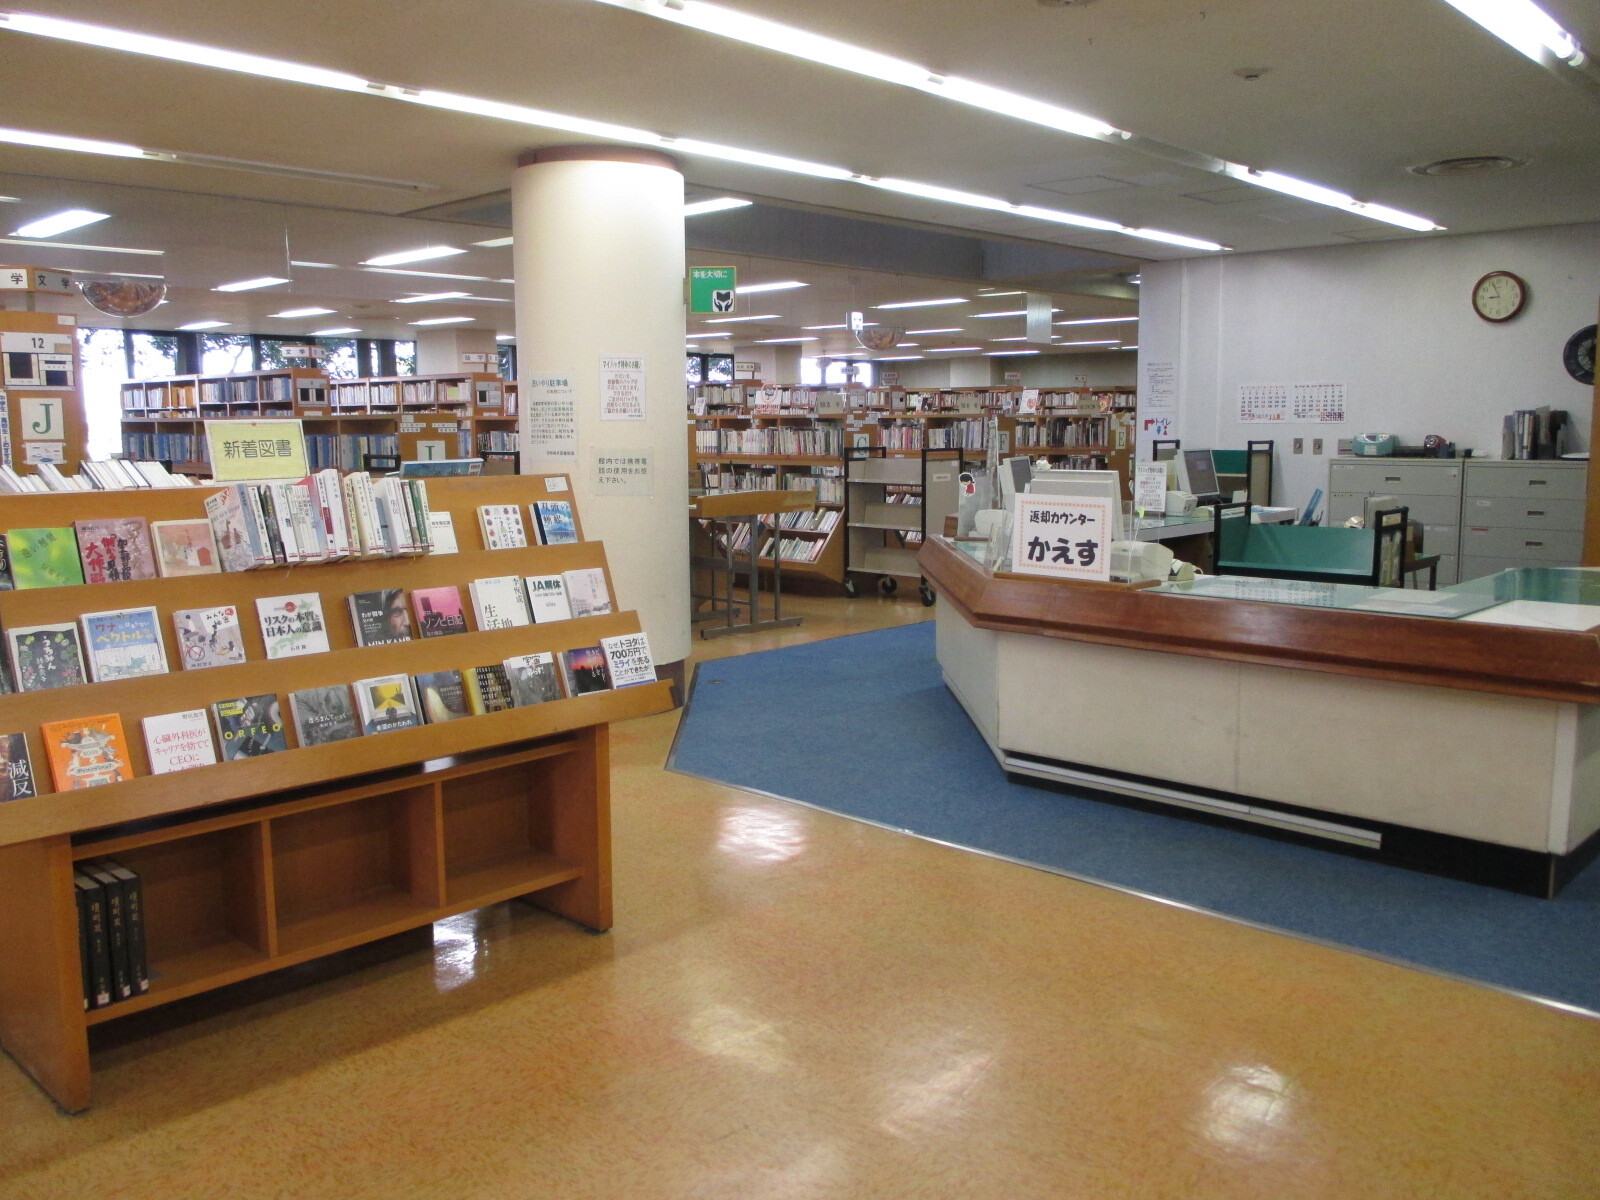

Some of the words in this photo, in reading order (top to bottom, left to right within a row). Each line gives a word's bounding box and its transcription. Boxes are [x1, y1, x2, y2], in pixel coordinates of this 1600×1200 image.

[693, 270, 728, 279] 本を大切に
[31, 337, 44, 349] 12
[32, 403, 54, 434] J
[1155, 418, 1172, 426] トイレ
[223, 438, 292, 459] 新着図書
[598, 457, 647, 465] 館内では携帯電
[598, 467, 648, 475] 話の使用をお控
[599, 476, 627, 484] え下さい。
[1029, 510, 1096, 526] 返却カウンター
[1027, 536, 1099, 567] かえす
[264, 610, 320, 626] リスクの本質と
[266, 621, 322, 638] 日本人の意識
[610, 647, 647, 660] 700万円で
[613, 656, 650, 668] ミライを売る
[224, 723, 282, 740] ORFEO
[169, 754, 200, 766] CEOに
[9, 759, 32, 797] 減反
